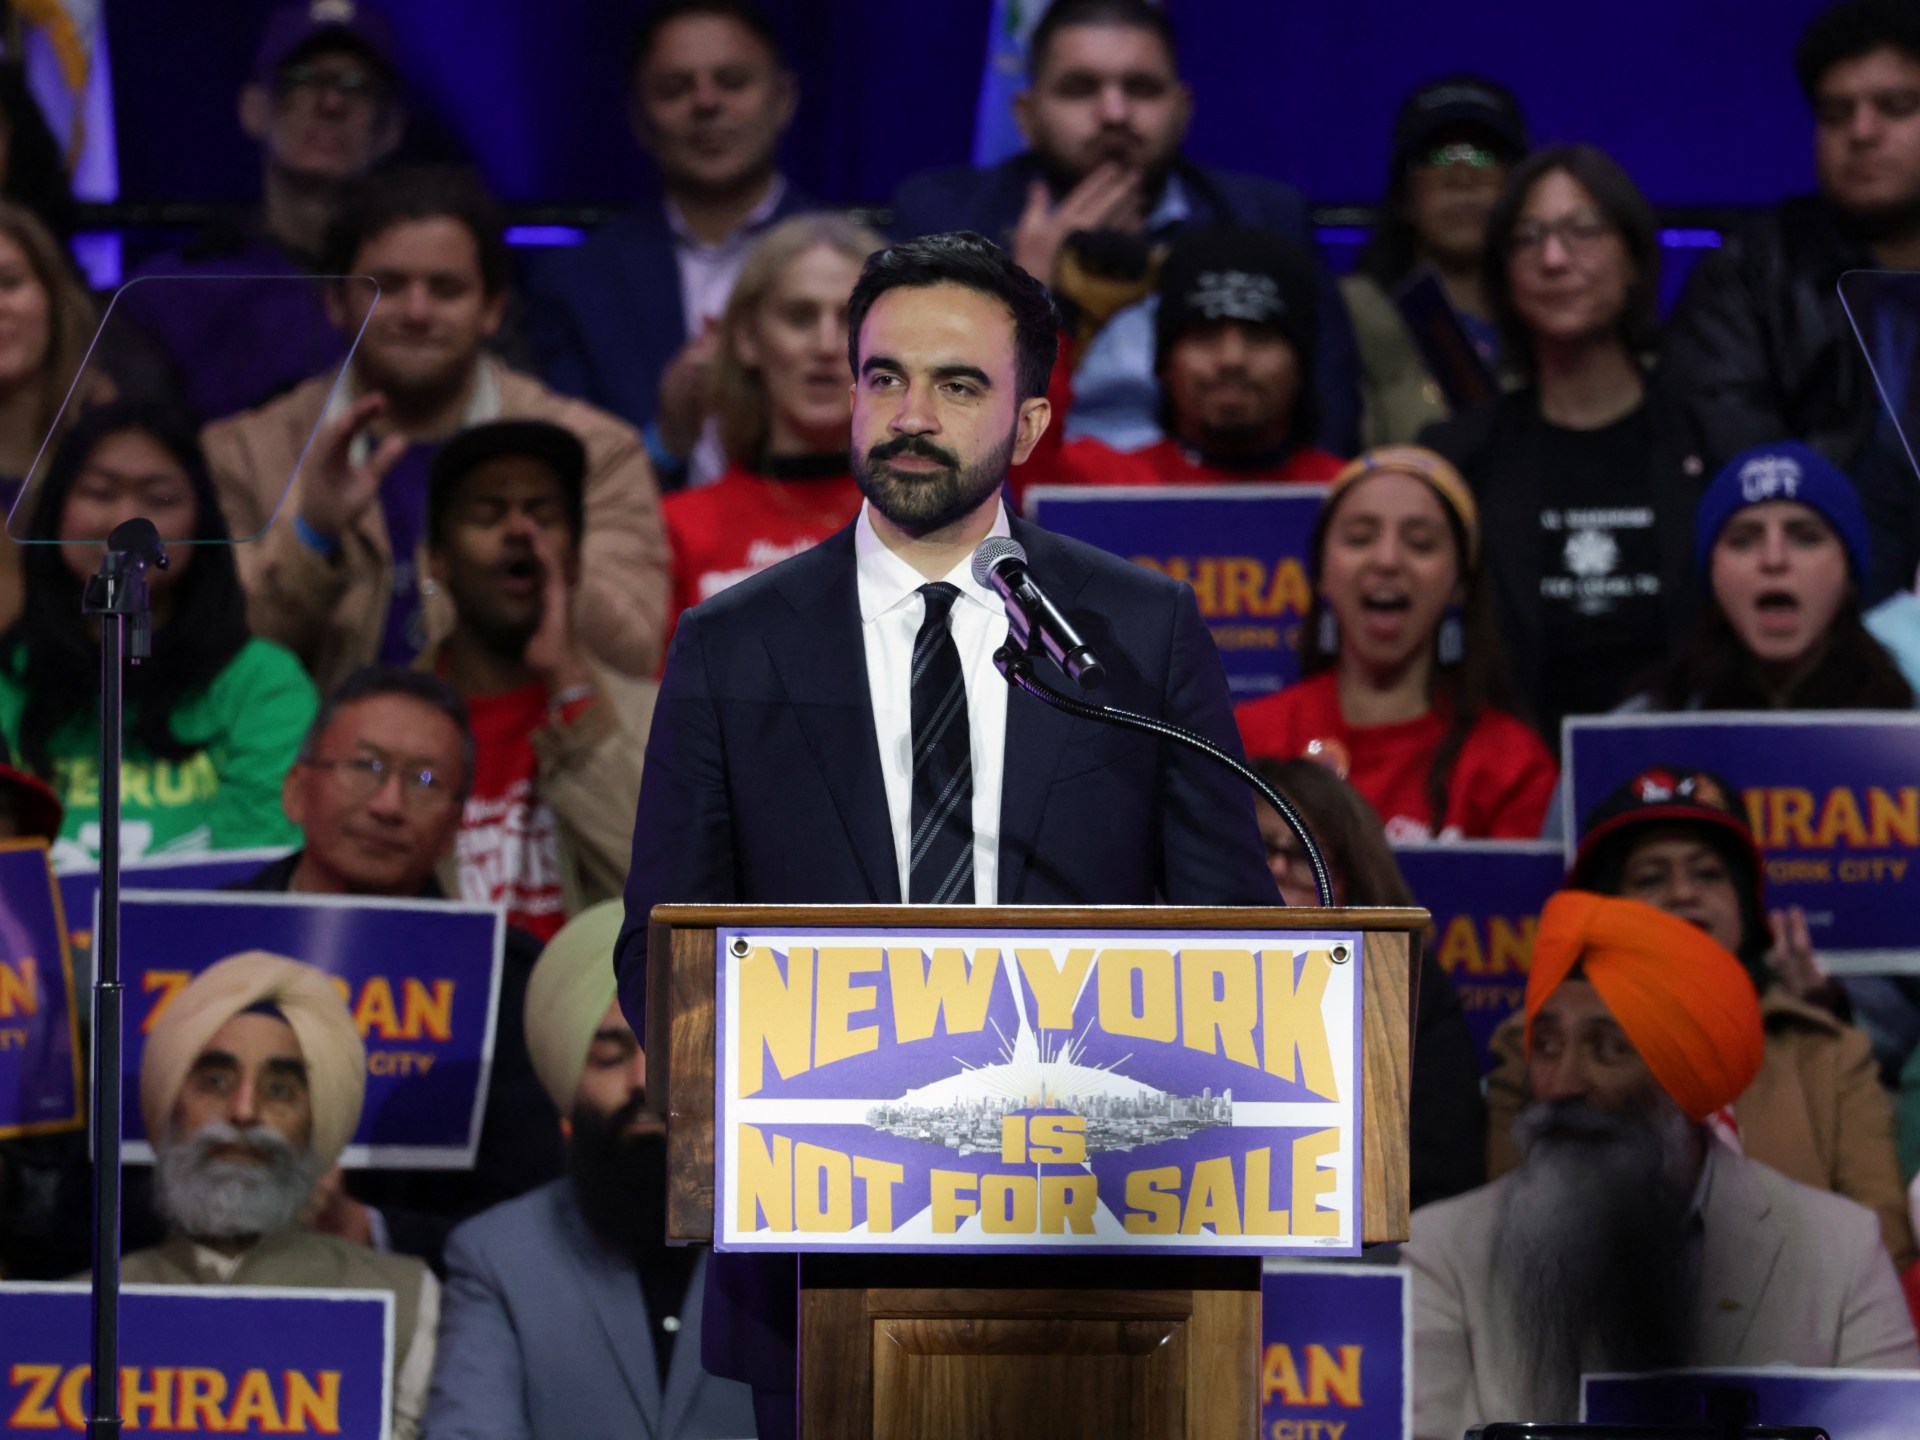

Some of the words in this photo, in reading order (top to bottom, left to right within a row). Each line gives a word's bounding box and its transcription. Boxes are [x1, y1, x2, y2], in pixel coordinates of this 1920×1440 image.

[1837, 857, 1907, 882] CITY
[738, 946, 1002, 1099] NEW
[1013, 948, 1340, 1103] YORK
[367, 1050, 435, 1076] CITY
[1002, 1115, 1087, 1163] IS
[736, 1122, 904, 1233] NOT
[930, 1168, 1098, 1234] FOR
[1124, 1126, 1340, 1236] SALE
[9, 1363, 342, 1434] ZOHRAN
